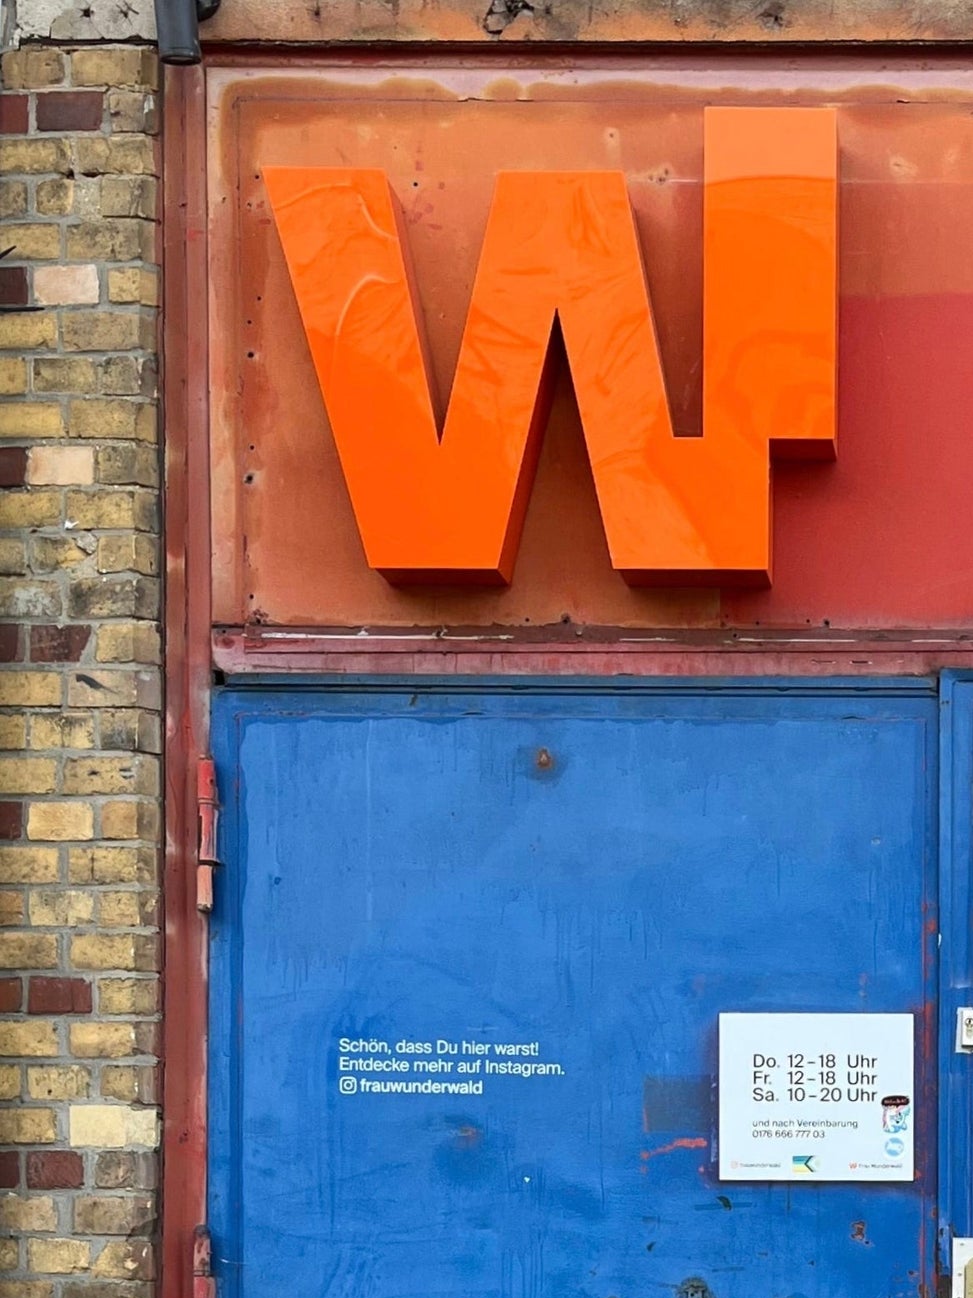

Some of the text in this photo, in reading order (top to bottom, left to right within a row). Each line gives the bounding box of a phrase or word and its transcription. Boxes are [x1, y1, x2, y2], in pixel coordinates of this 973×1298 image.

[339, 1038, 540, 1056] Schön, dass Du hier warst!
[339, 1057, 565, 1077] Entdecke mehr auf Instagram.
[753, 1053, 781, 1069] Do.
[847, 1053, 878, 1069] Uhr
[753, 1070, 772, 1085] Fr.
[847, 1070, 878, 1086] Uhr
[360, 1078, 483, 1095] frauwunderwald
[752, 1087, 780, 1103] Sa.
[847, 1087, 878, 1103] Uhr
[752, 1119, 858, 1130] und nach Vereinbarung
[752, 1130, 773, 1138] 0176
[795, 1130, 811, 1138] 777
